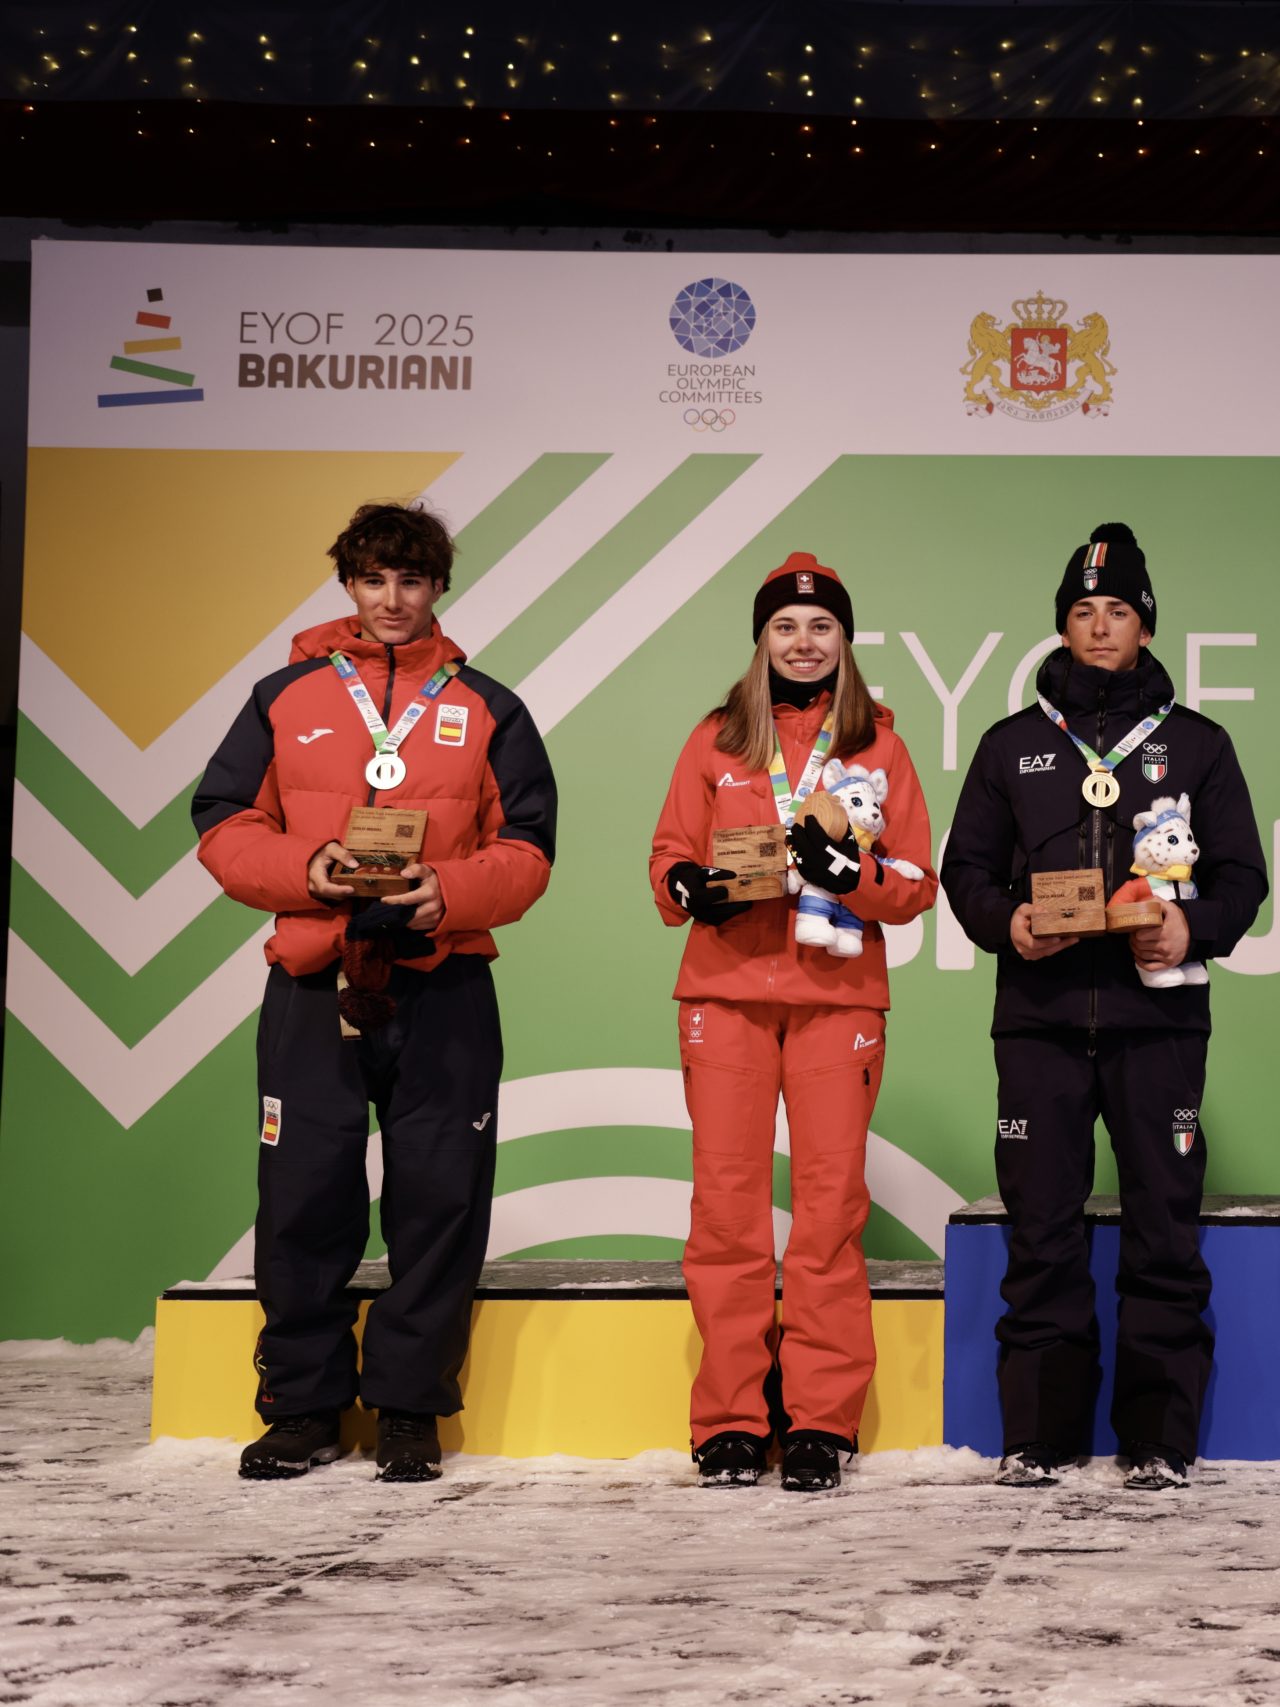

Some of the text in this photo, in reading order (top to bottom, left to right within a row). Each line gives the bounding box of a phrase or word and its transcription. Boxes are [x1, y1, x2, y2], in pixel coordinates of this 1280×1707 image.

[239, 311, 474, 347] EYOF 2025
[238, 353, 473, 390] BAKURIANI
[667, 363, 756, 377] EUROPEAN
[676, 377, 746, 390] OLYMPIC
[658, 390, 763, 404] COMMITTEES
[1019, 753, 1057, 770] EA7
[998, 1119, 1028, 1135] EA7
